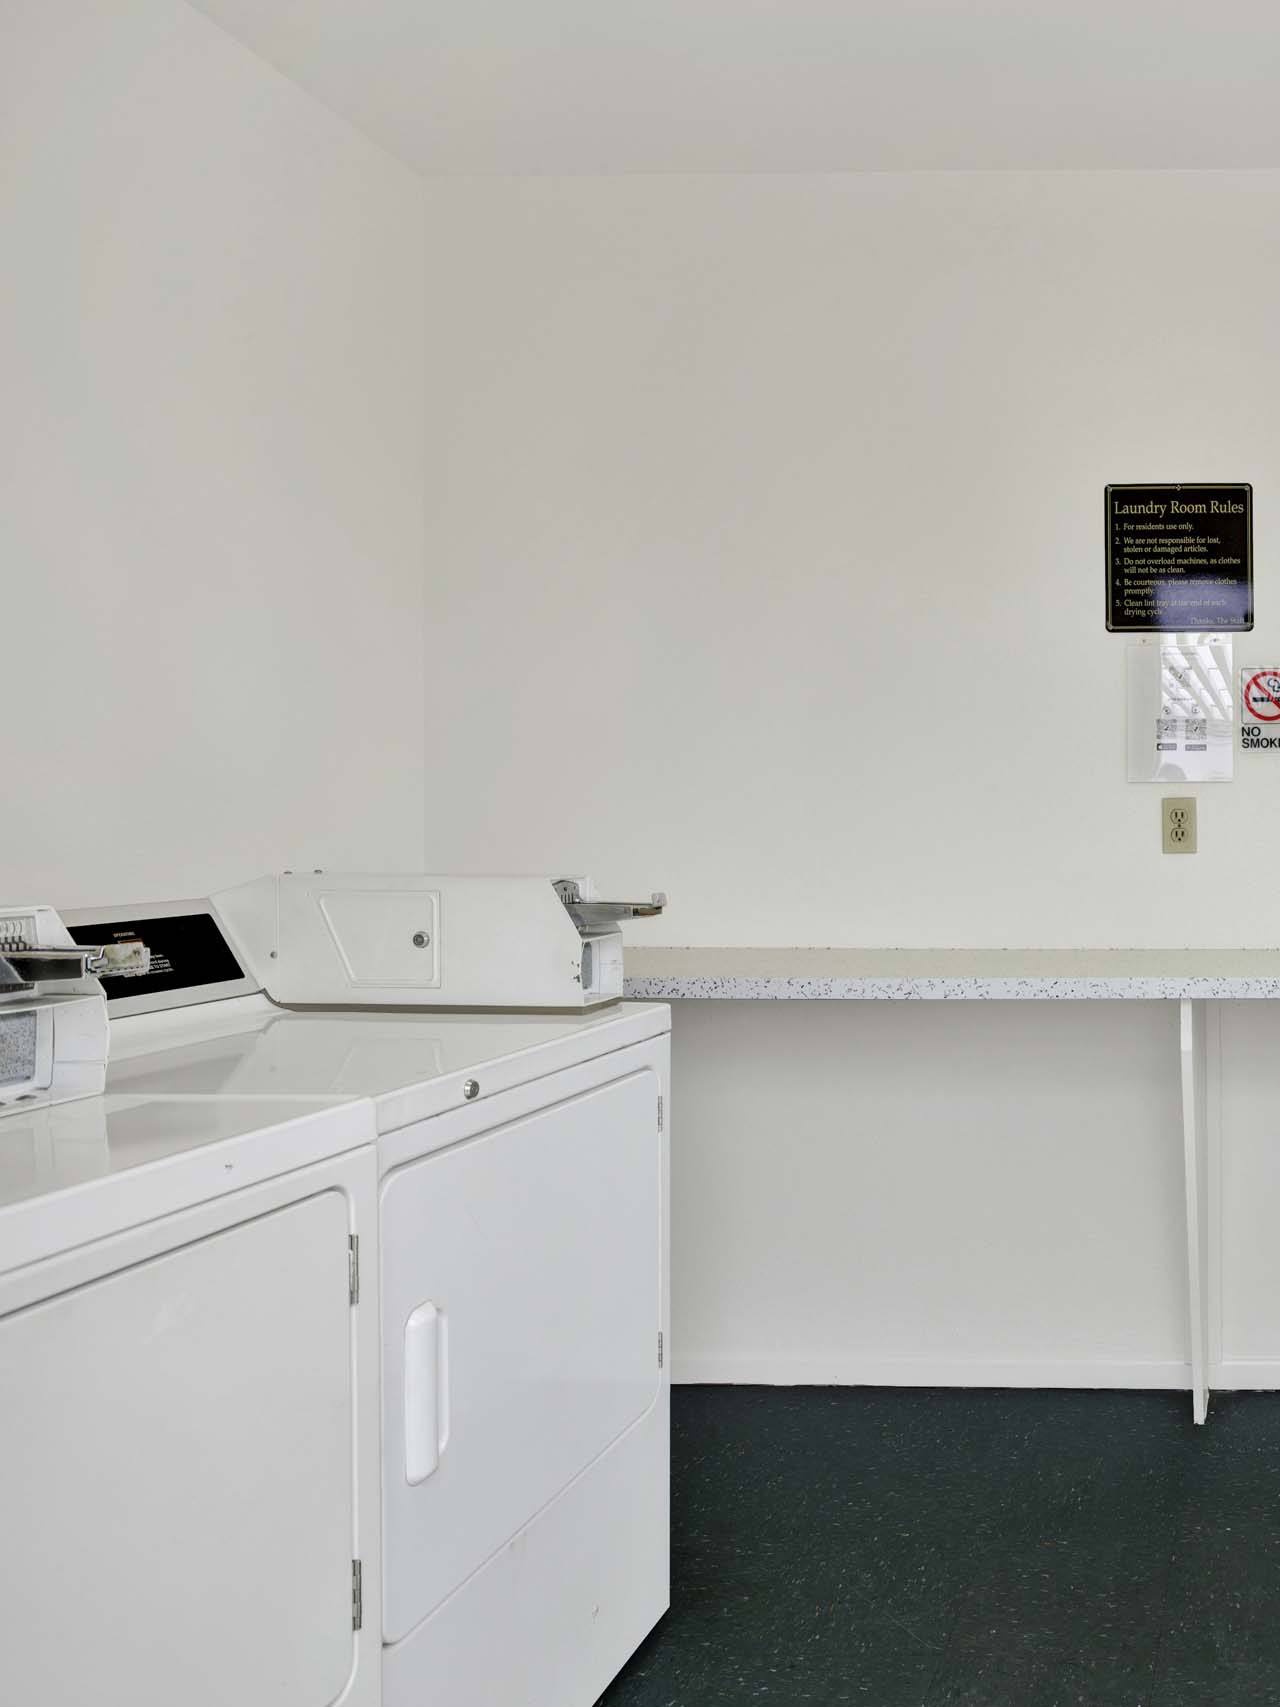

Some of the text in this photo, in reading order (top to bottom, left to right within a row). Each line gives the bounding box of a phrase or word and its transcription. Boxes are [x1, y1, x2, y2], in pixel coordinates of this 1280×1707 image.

[1114, 499, 1244, 518] Laundry Room Rules
[1114, 523, 1121, 531] 1.
[1123, 522, 1135, 531] For
[1135, 522, 1165, 531] residents
[1178, 522, 1195, 532] only.
[1114, 537, 1121, 545] 2.
[1158, 536, 1195, 546] responsible
[1196, 536, 1206, 544] for
[1207, 536, 1221, 545] lost,
[1123, 545, 1144, 553] stolen
[1152, 545, 1183, 554] damaged
[1183, 545, 1209, 553] articles.
[1123, 557, 1134, 565] Do
[1146, 557, 1176, 565] overload
[1176, 557, 1209, 566] machines,
[1218, 556, 1241, 564] clothes
[1123, 566, 1137, 574] will
[1149, 566, 1157, 574] be
[1167, 566, 1186, 574] clean.
[1124, 578, 1133, 586] Be
[1168, 577, 1189, 587] please
[1214, 577, 1238, 585] clothes
[1123, 599, 1143, 607] Clean
[1144, 599, 1155, 607] lint
[1123, 608, 1146, 618] drying
[1241, 726, 1262, 737] NO
